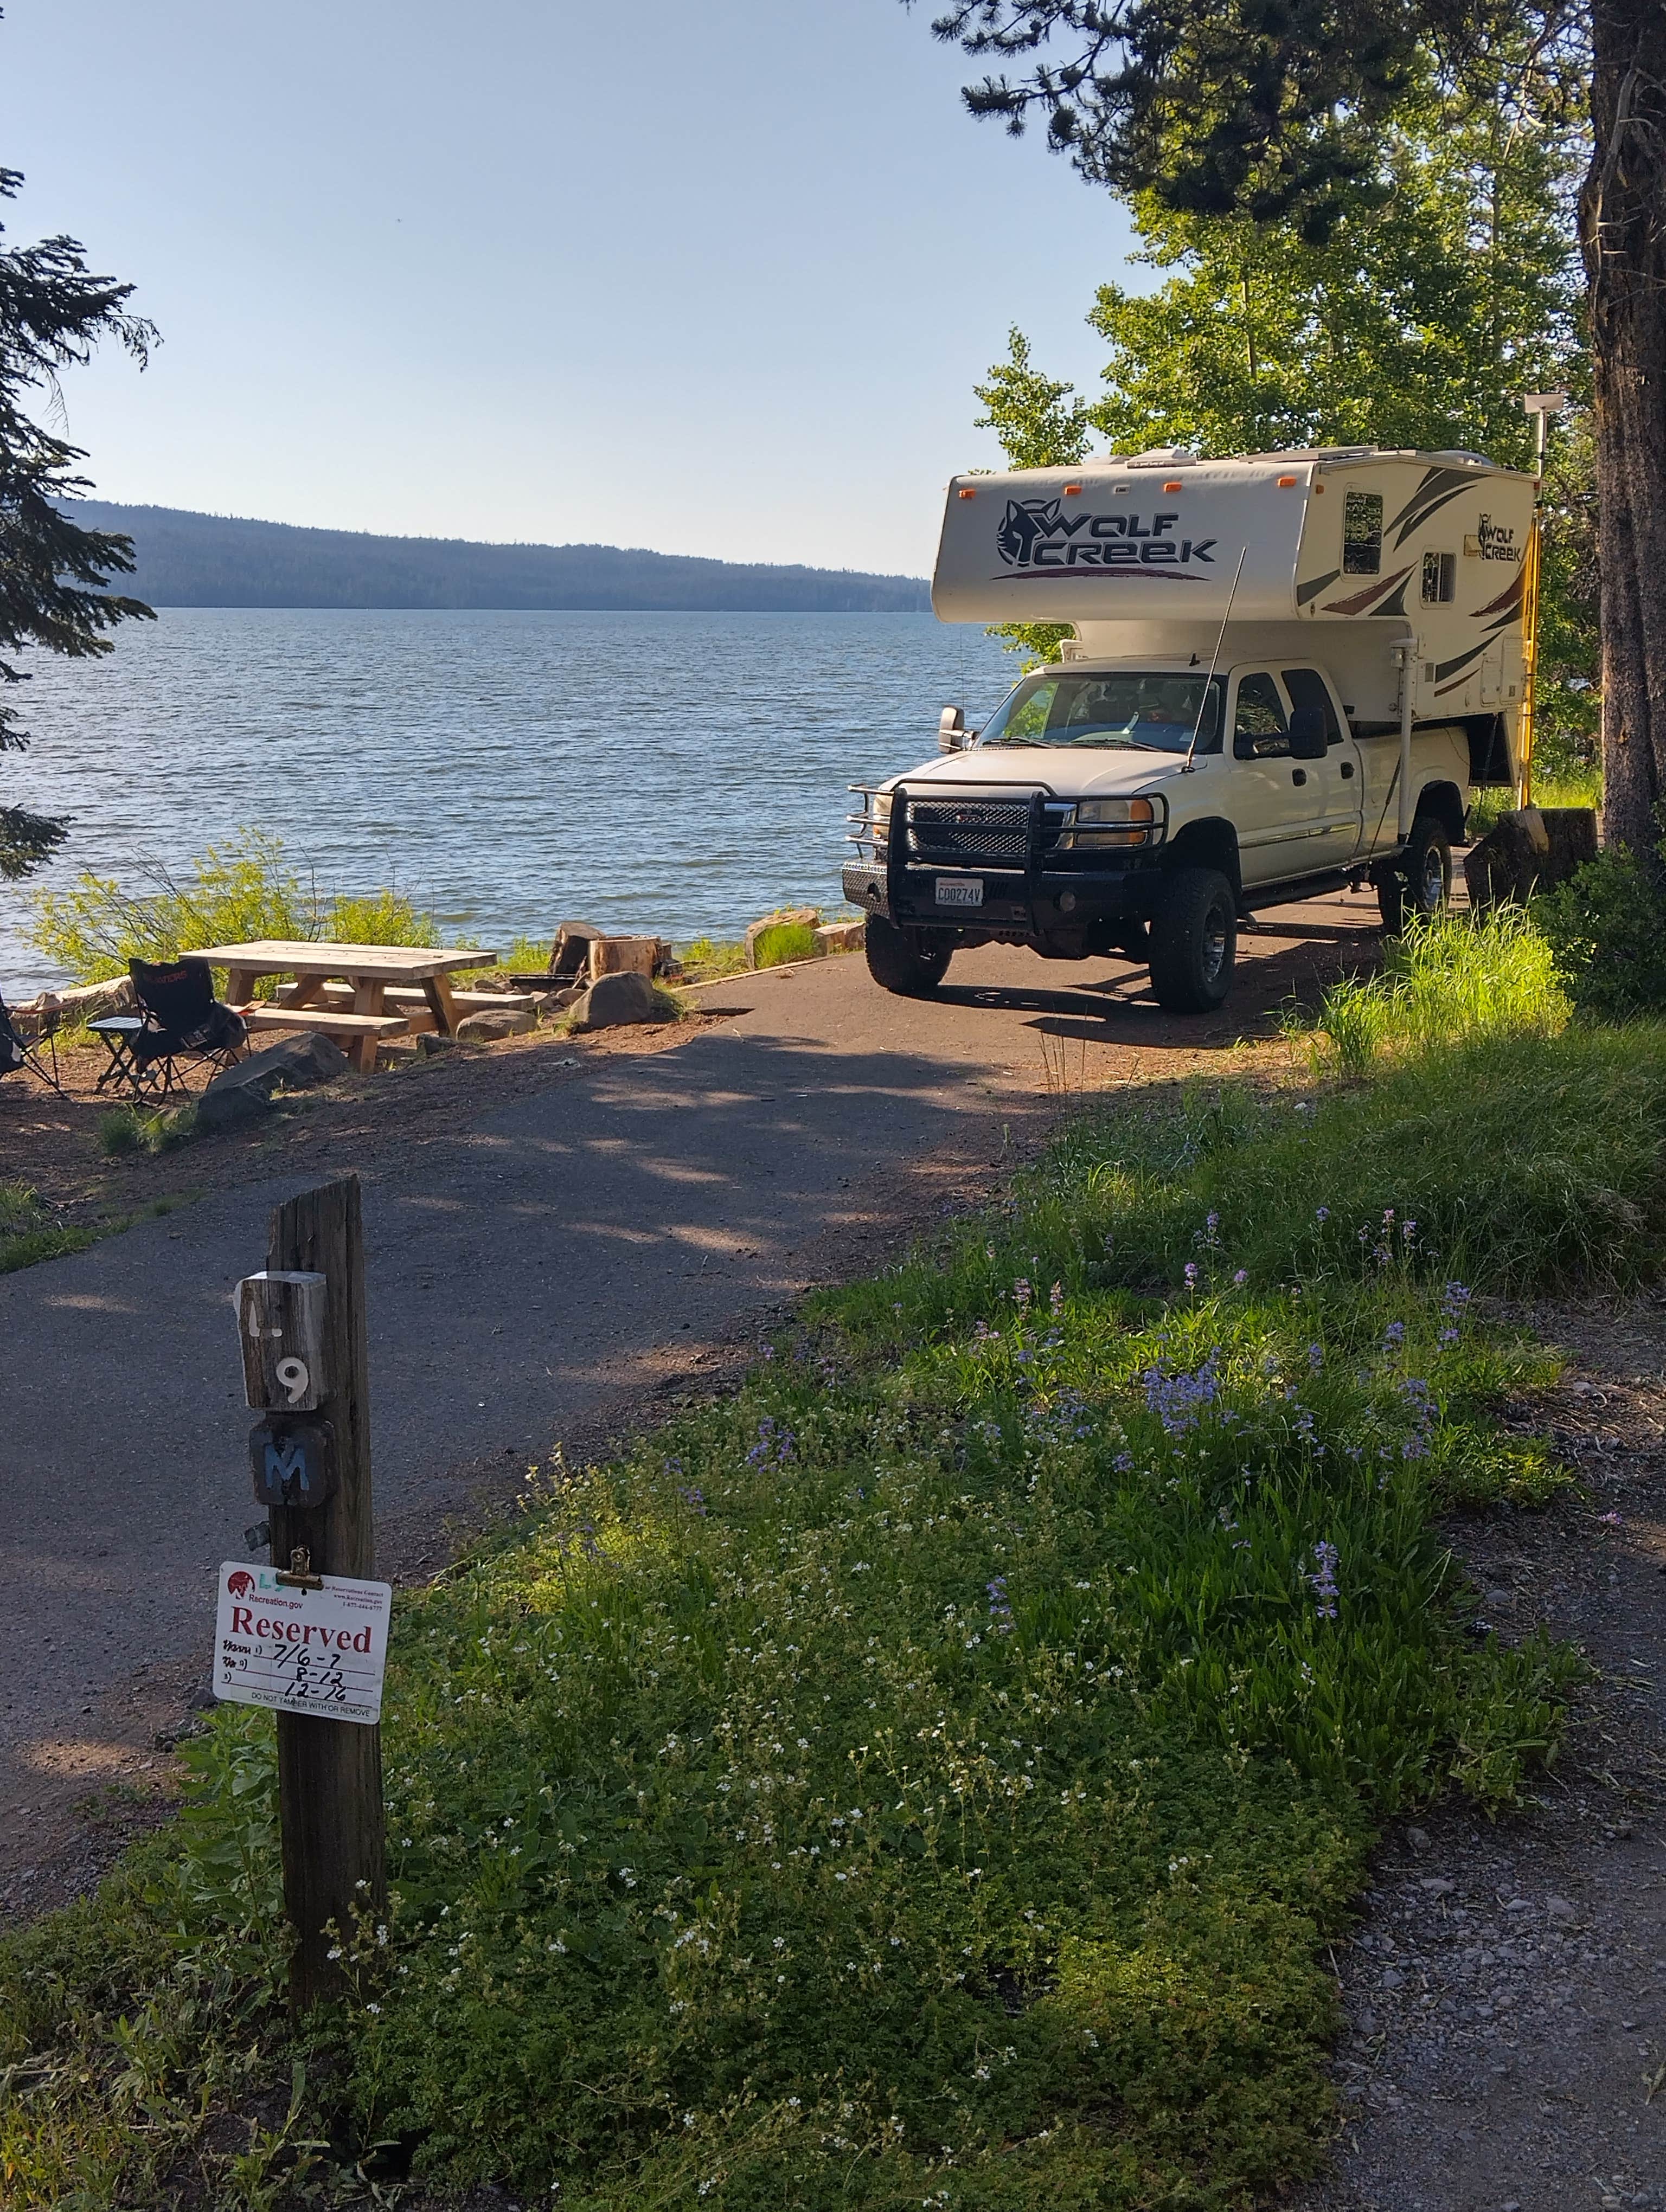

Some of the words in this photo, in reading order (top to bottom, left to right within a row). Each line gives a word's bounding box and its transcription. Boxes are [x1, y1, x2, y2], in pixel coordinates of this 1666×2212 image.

[1031, 512, 1179, 538] WOLF
[1485, 526, 1514, 544] WOLF
[1033, 538, 1219, 565] CREEK
[1485, 543, 1521, 562] CREEK
[275, 1356, 309, 1404] 9
[265, 1442, 310, 1491] M
[249, 1594, 303, 1610] Recreation.gov
[229, 1605, 372, 1653] Reserved
[309, 1702, 326, 1711] WITH
[340, 1707, 370, 1718] REMOVE
